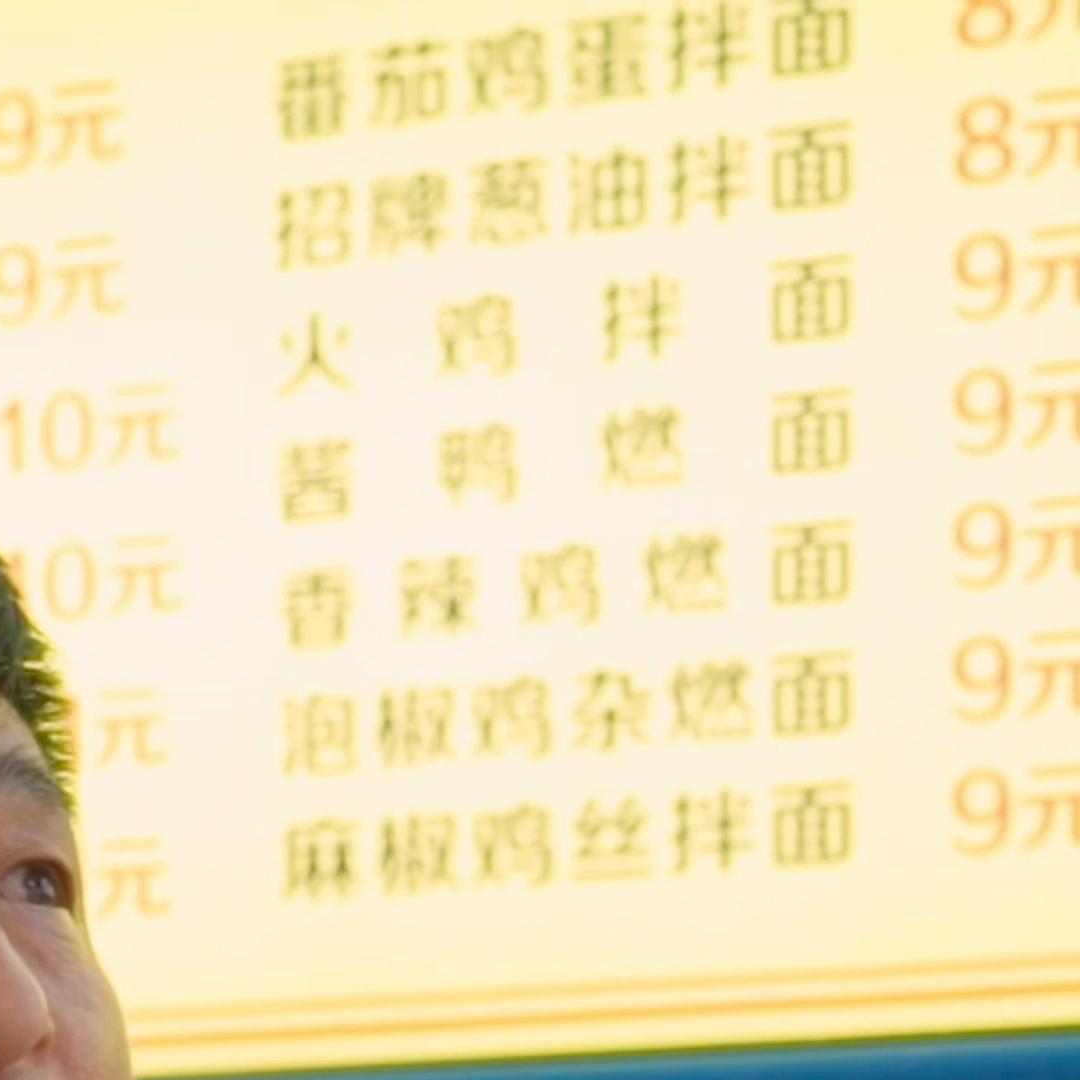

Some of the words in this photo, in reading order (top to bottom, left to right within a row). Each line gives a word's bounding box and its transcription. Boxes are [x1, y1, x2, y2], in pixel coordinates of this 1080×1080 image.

[275, 0, 855, 144] 番茄鸡蛋拌面
[275, 119, 856, 270] 招牌葱油拌面
[277, 253, 856, 397] 火鸡拌面
[282, 519, 855, 652] 香辣鸡燃面
[281, 650, 855, 779] 泡椒鸡杂燃面
[280, 781, 856, 905] 麻椒鸡丝拌面
